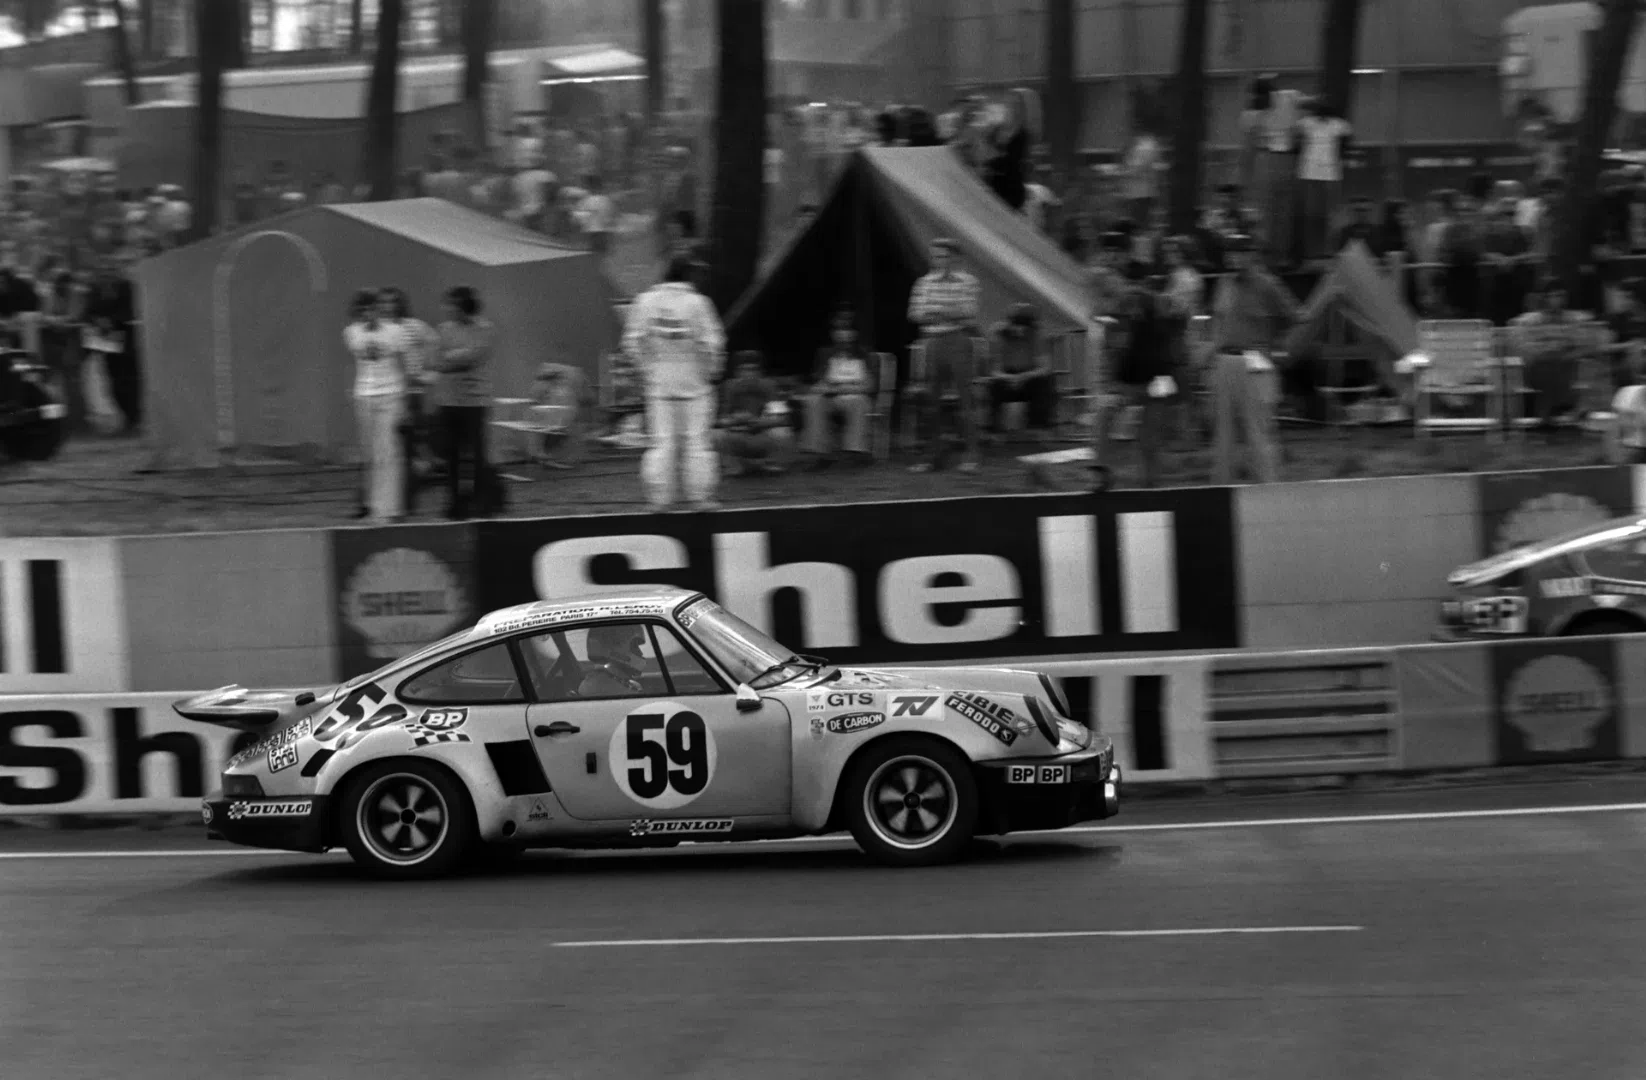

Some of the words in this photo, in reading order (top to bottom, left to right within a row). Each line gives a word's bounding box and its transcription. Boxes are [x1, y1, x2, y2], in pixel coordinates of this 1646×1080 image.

[532, 510, 1180, 657] Shell
[561, 612, 584, 620] PARIS
[827, 692, 874, 707] GTS
[428, 710, 464, 728] BP
[830, 719, 842, 731] DE
[843, 713, 883, 729] CARBON
[948, 698, 1000, 733] FERODO
[626, 710, 709, 799] 59
[1012, 768, 1034, 782] BP
[1042, 768, 1063, 782] BP
[247, 804, 312, 814] DUNLOP
[650, 820, 733, 832] DUNLOP
